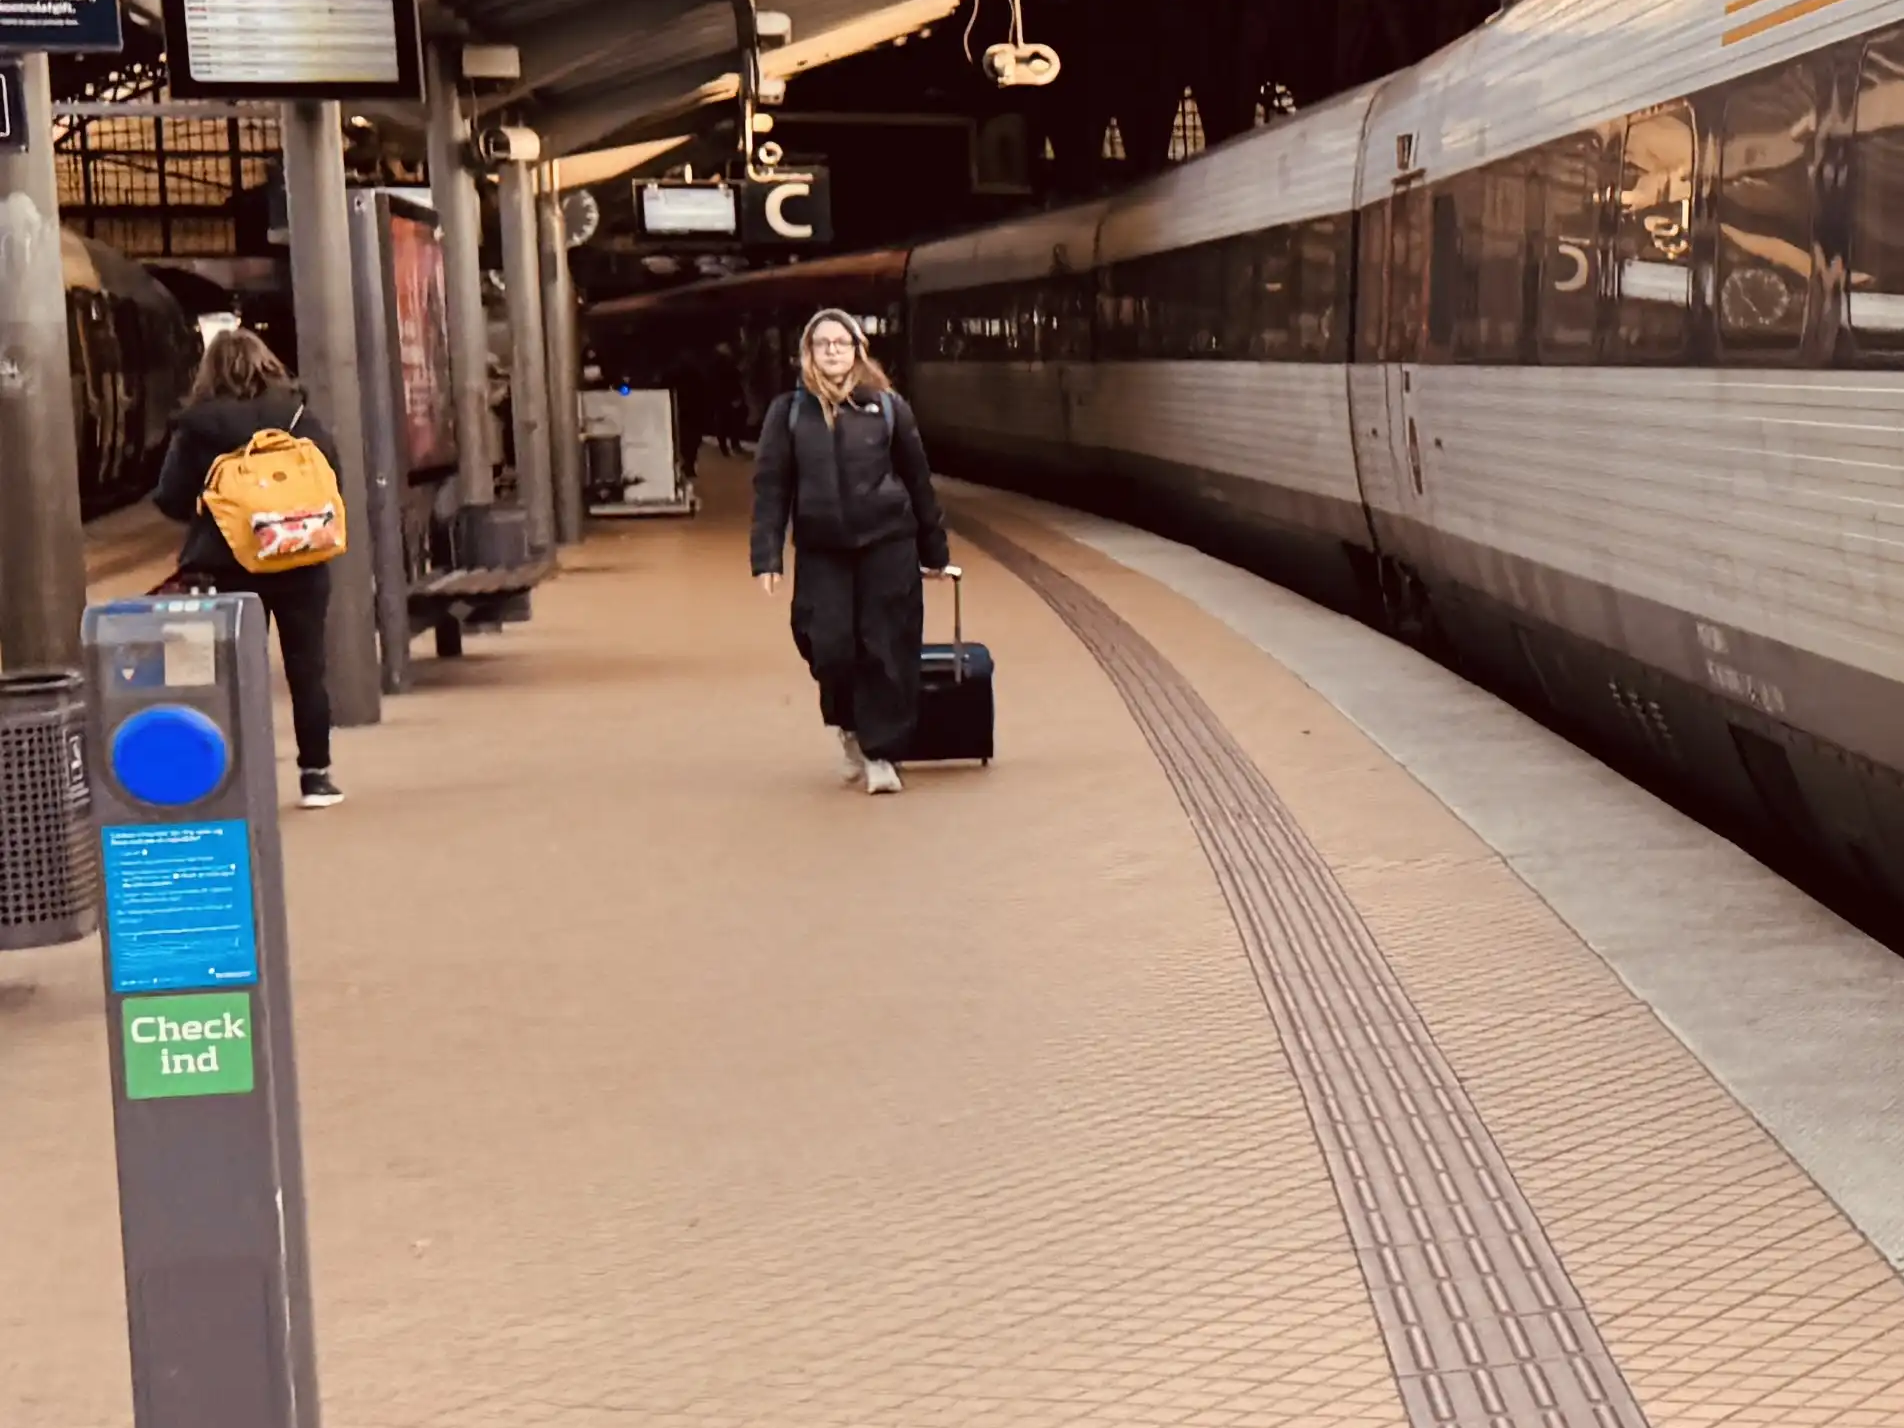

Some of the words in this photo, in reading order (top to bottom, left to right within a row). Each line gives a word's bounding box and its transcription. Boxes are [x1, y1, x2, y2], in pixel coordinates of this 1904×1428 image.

[764, 183, 813, 238] C
[130, 1012, 247, 1043] Check
[161, 1045, 219, 1075] ind
